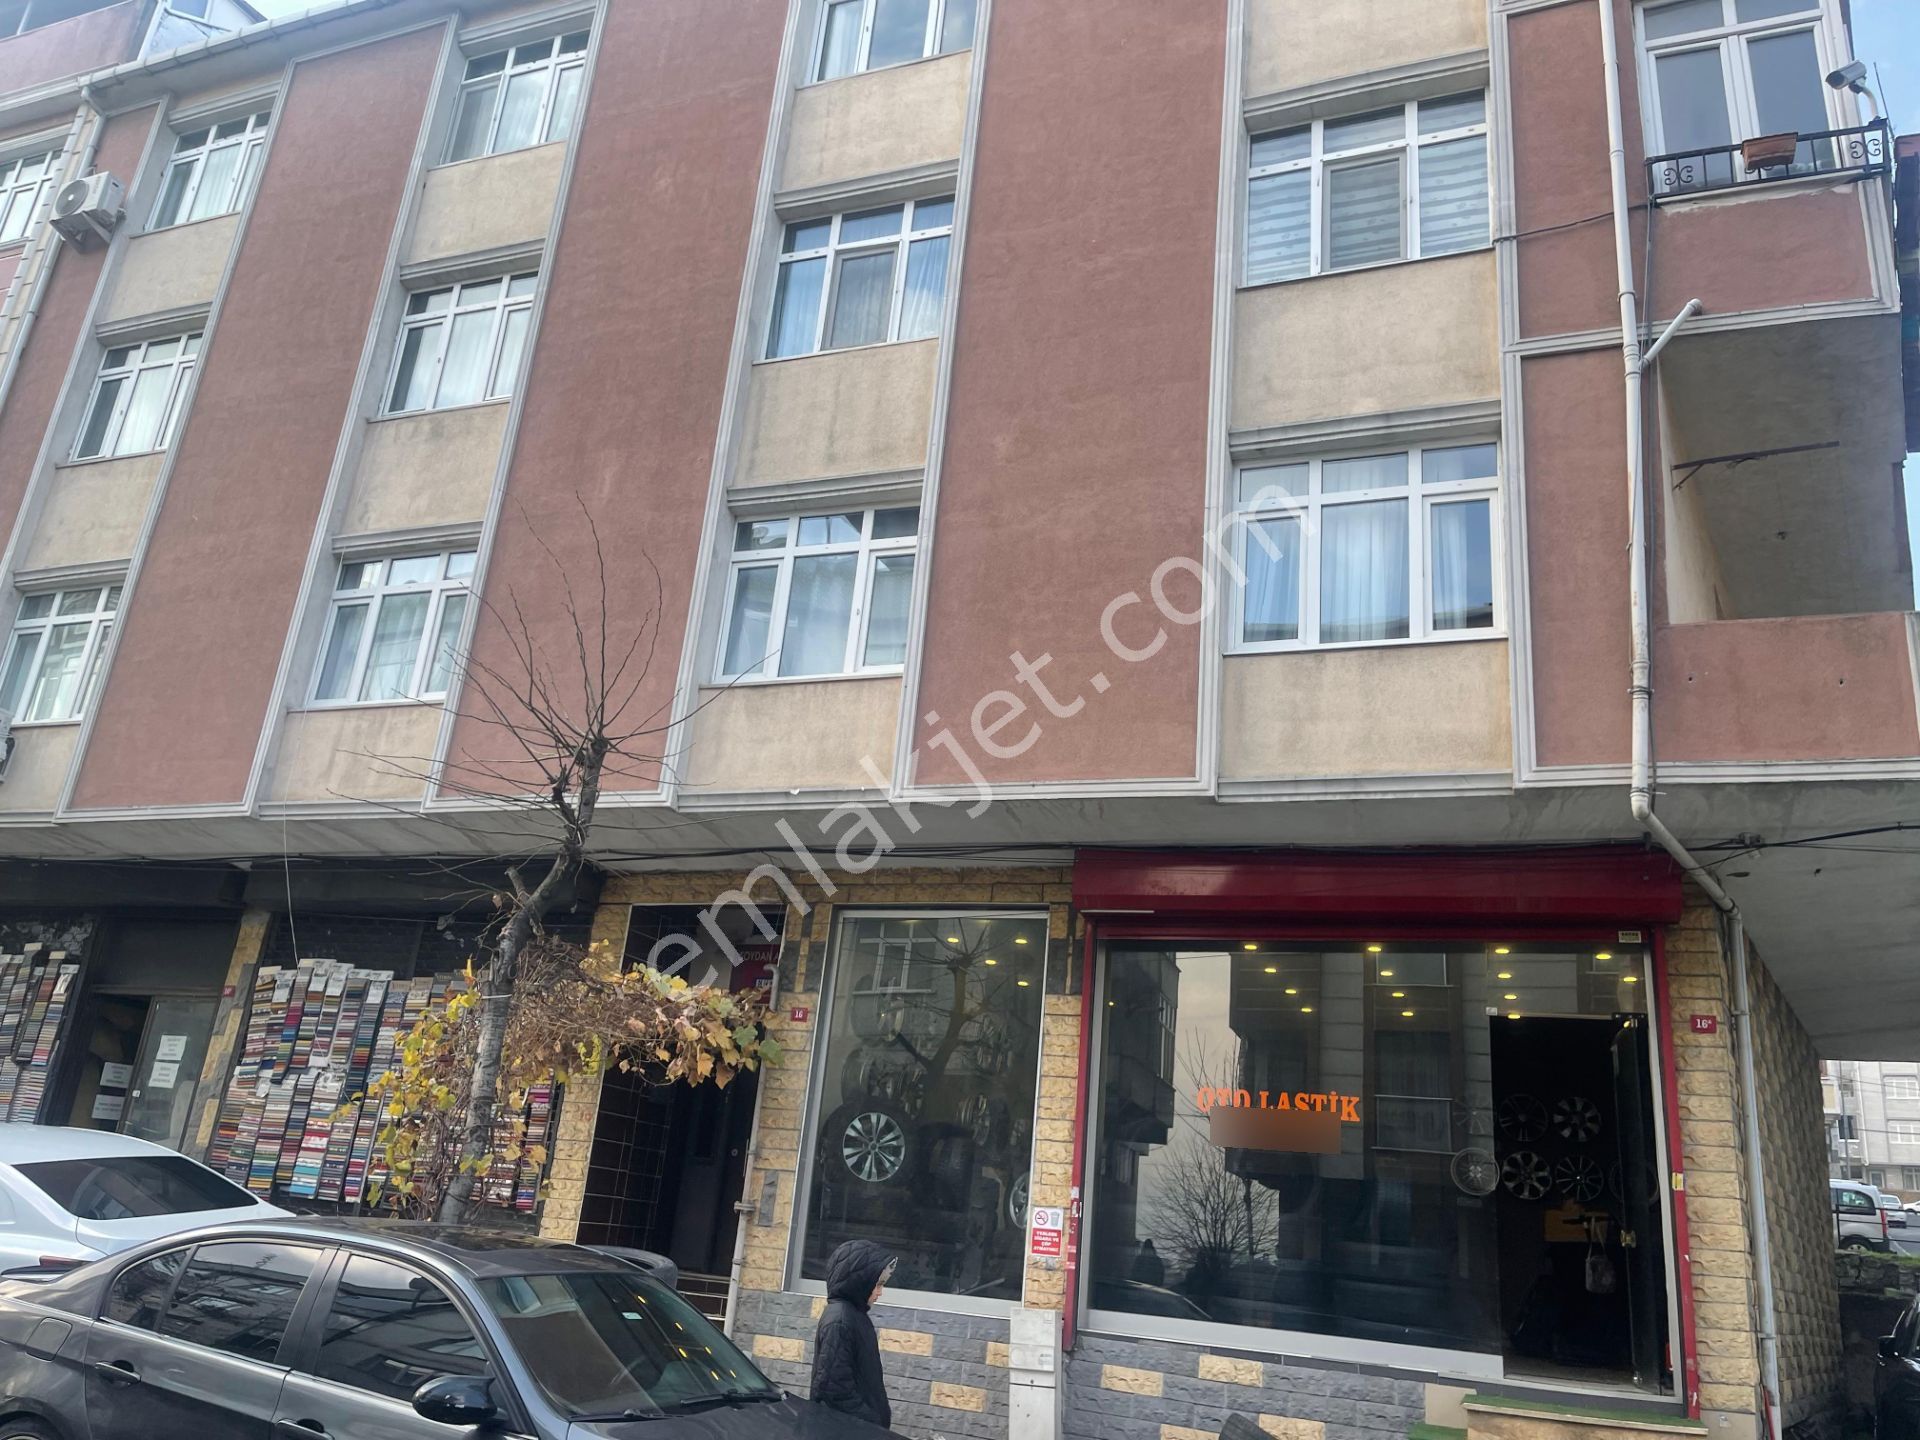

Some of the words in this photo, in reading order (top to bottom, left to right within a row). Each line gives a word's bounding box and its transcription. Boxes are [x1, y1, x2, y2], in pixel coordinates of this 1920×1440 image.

[795, 1010, 803, 1018] 16
[1196, 1087, 1251, 1113] OTO
[1259, 1090, 1361, 1122] LASTİK
